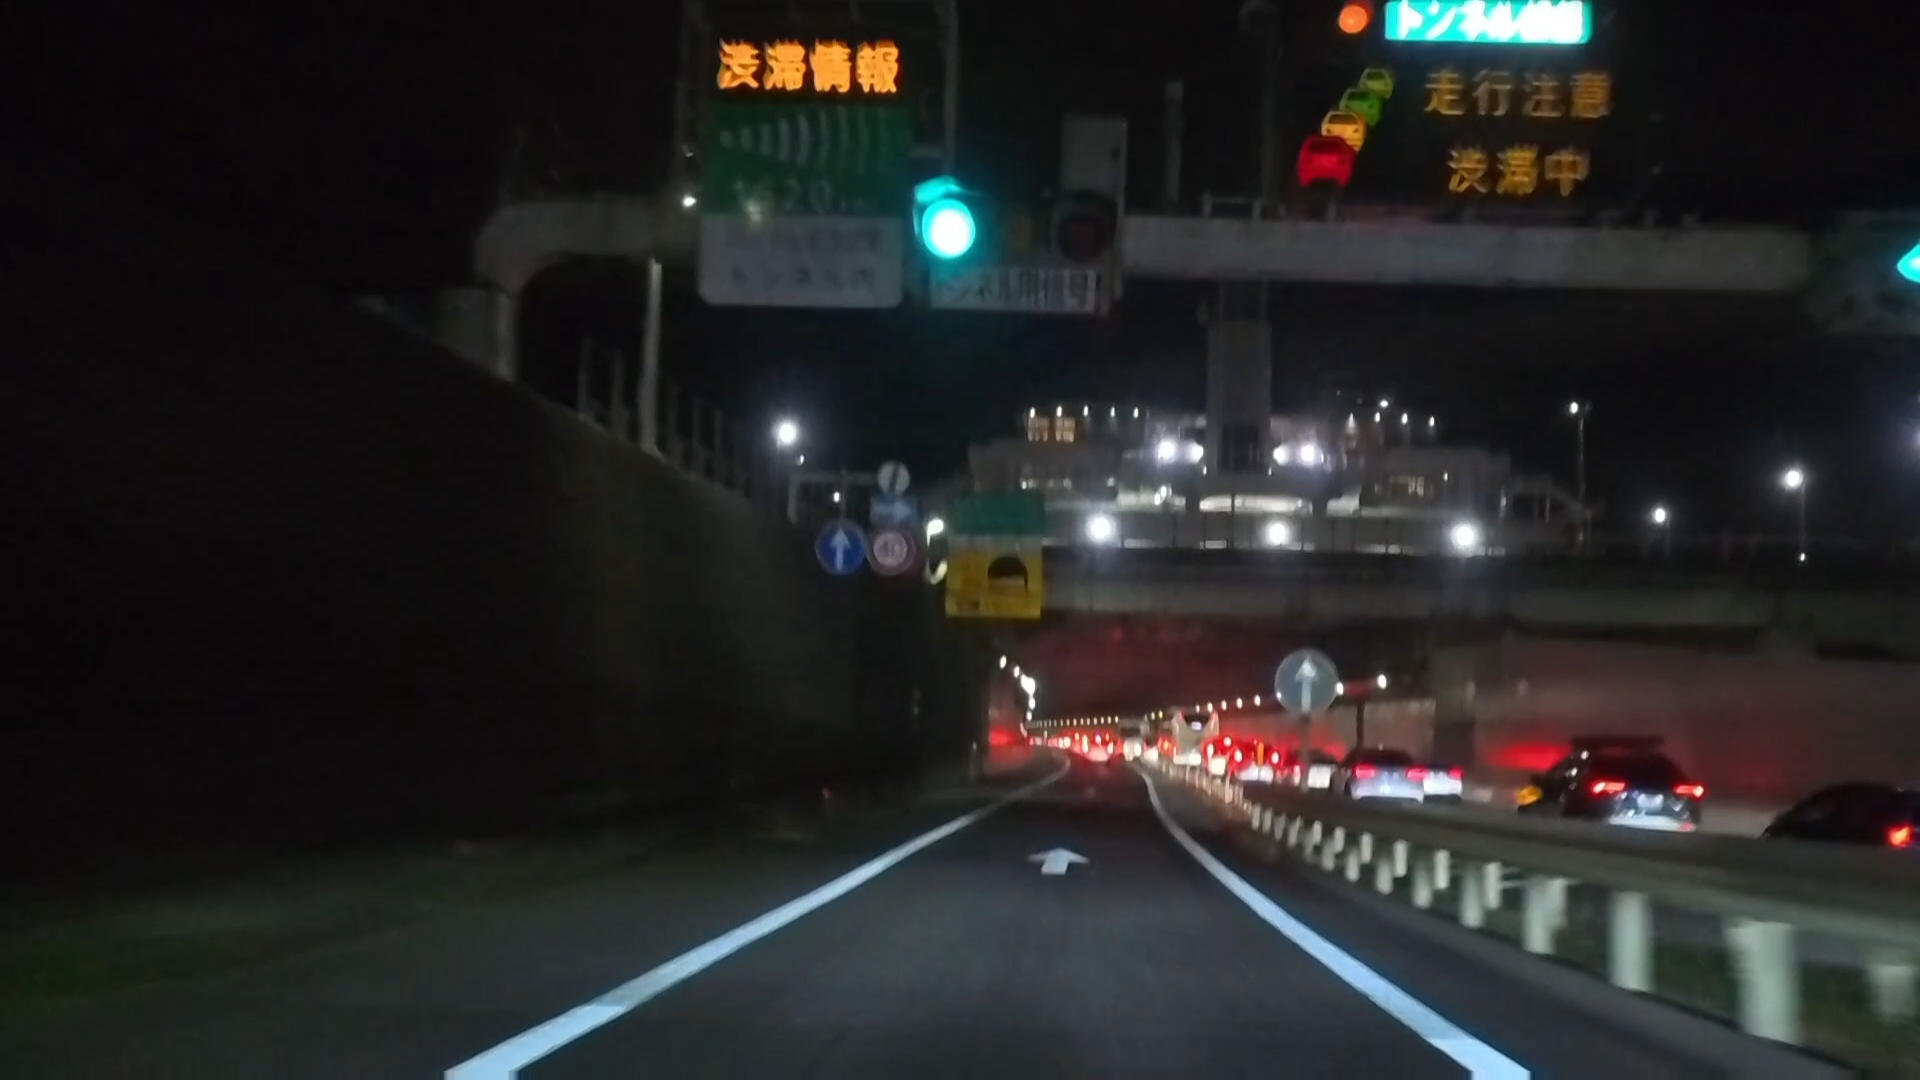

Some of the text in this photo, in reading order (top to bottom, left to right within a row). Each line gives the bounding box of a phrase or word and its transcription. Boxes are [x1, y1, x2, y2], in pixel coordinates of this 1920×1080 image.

[717, 39, 900, 94] 渋滞情報
[1424, 68, 1612, 118] 走行注意
[1448, 147, 1590, 197] 渋滞中
